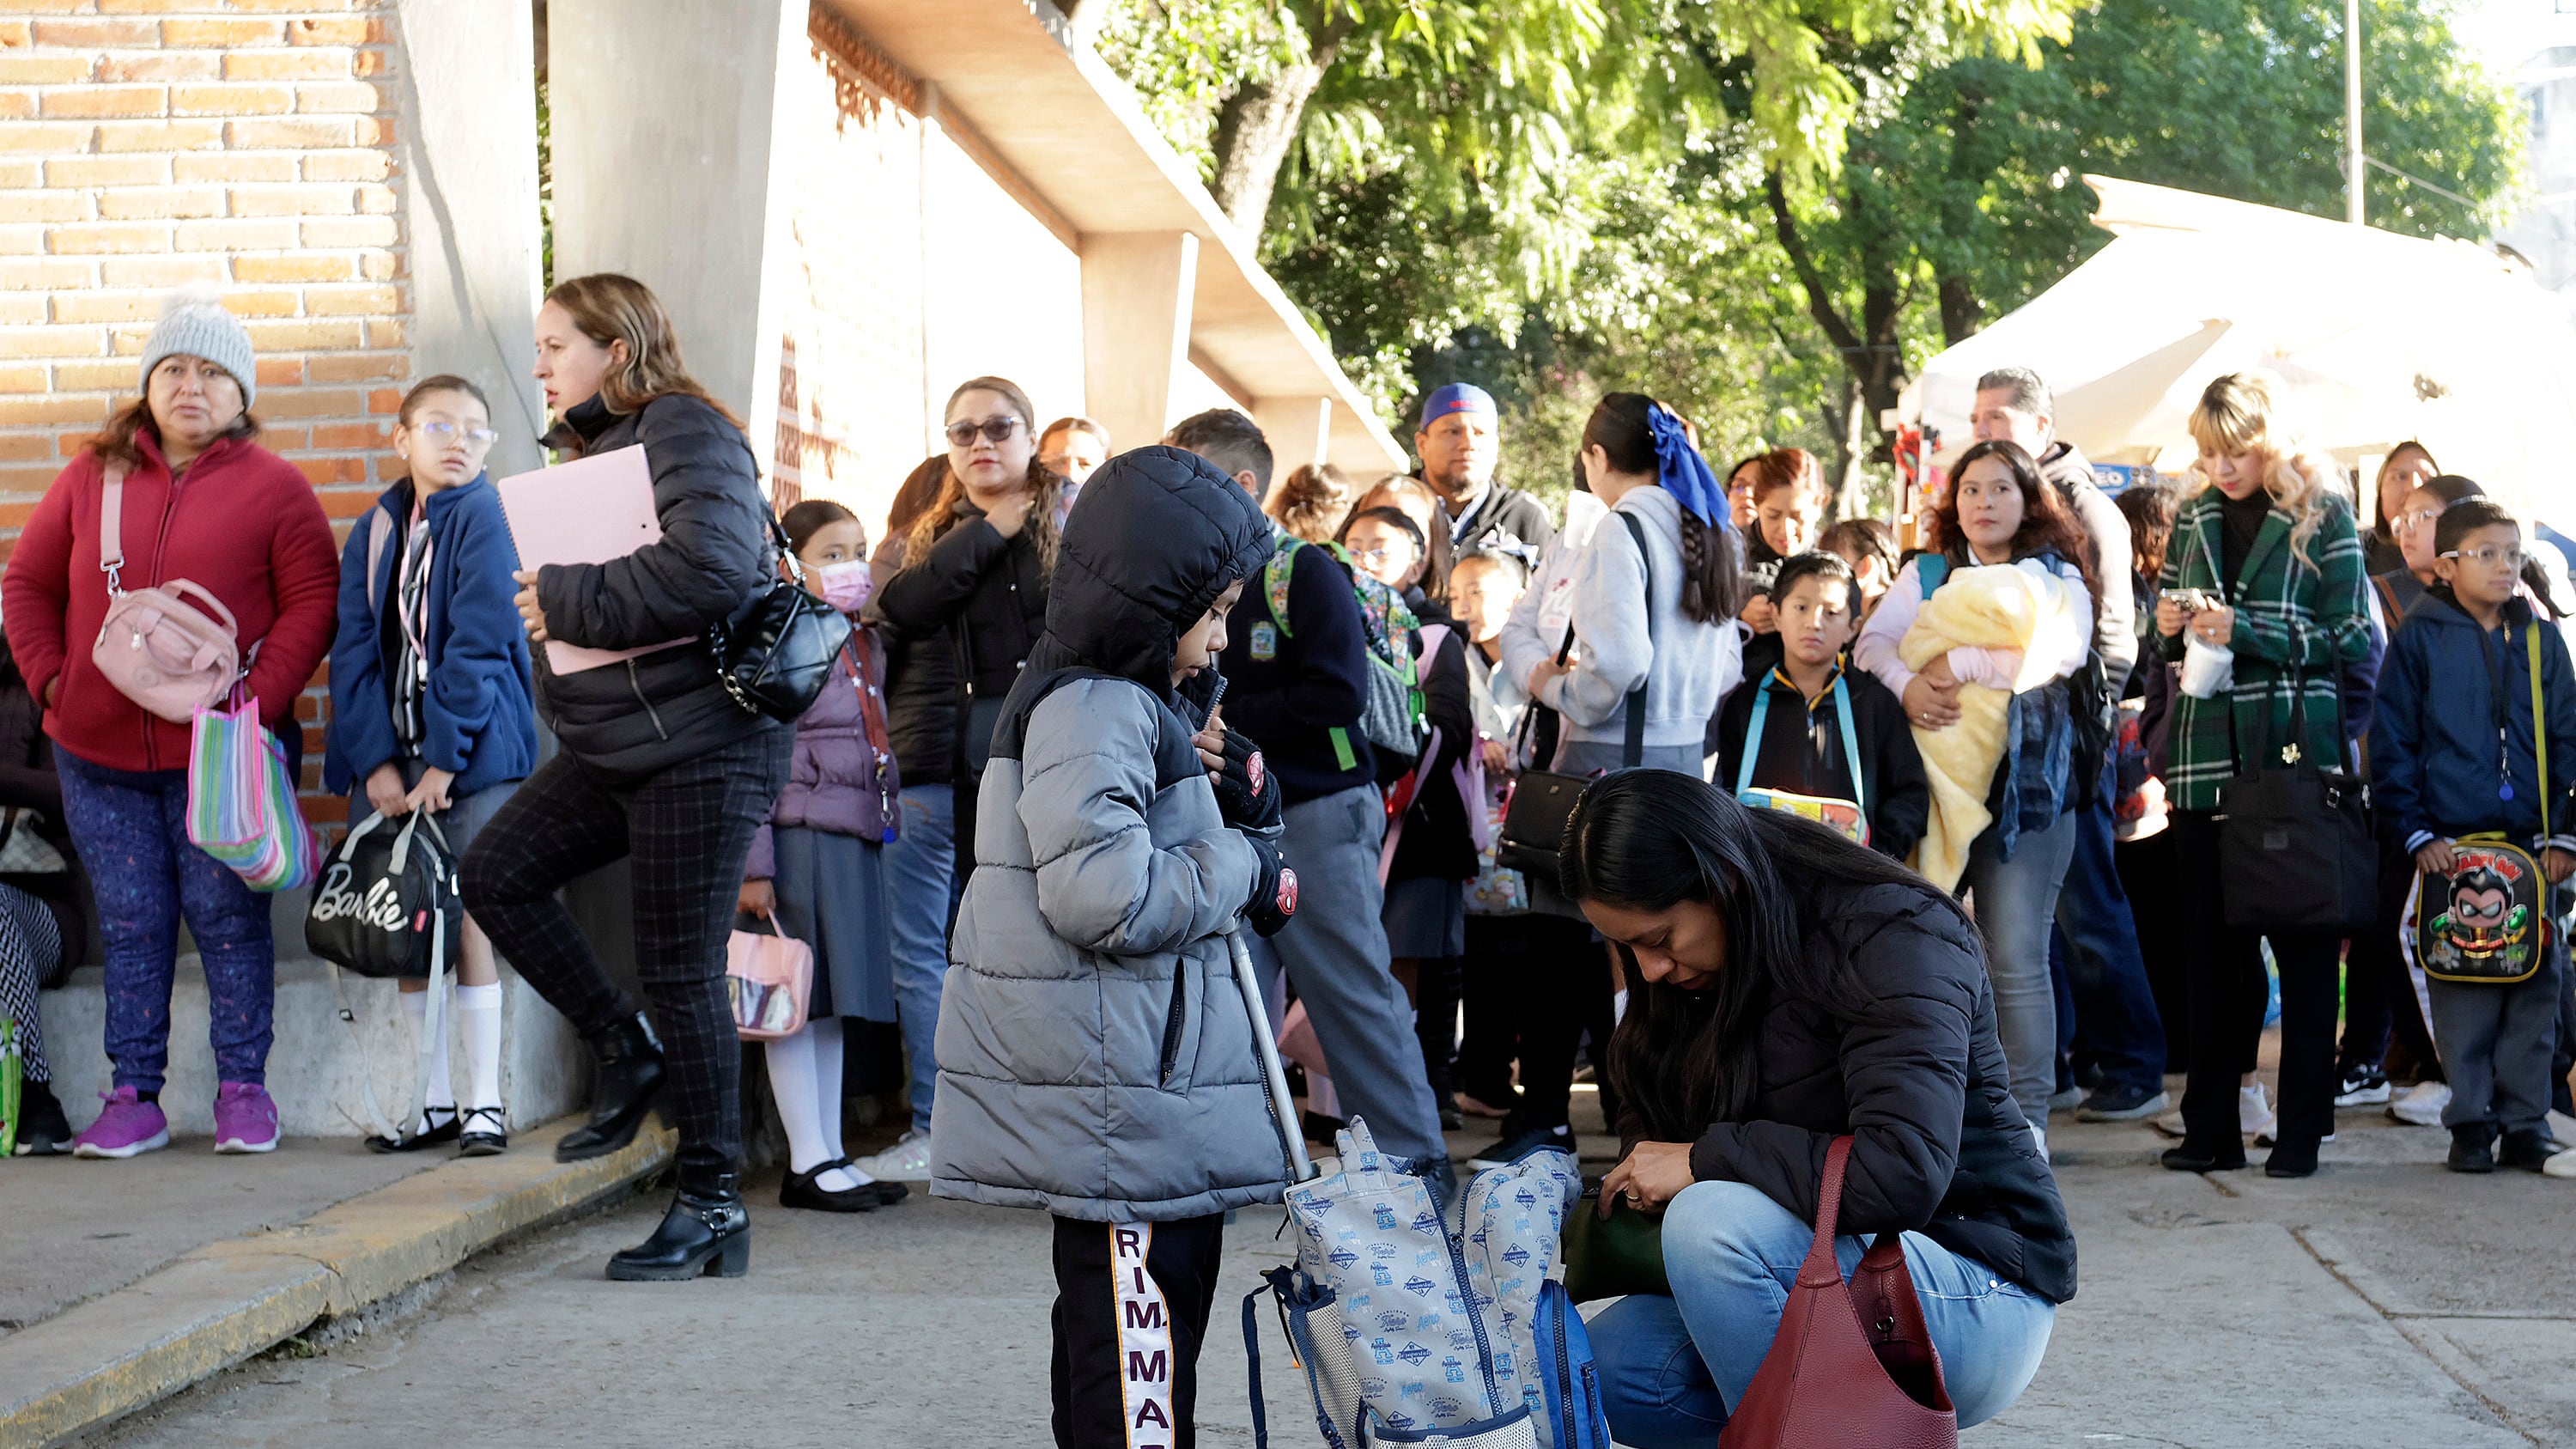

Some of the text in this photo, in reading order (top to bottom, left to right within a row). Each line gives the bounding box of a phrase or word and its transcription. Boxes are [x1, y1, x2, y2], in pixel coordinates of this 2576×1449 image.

[312, 862, 409, 931] Barbie
[1346, 1294, 1370, 1313] Aero
[1417, 1313, 1440, 1332] Aero
[1116, 1229, 1170, 1449] RIMMA
[1400, 1382, 1424, 1401] Aero
